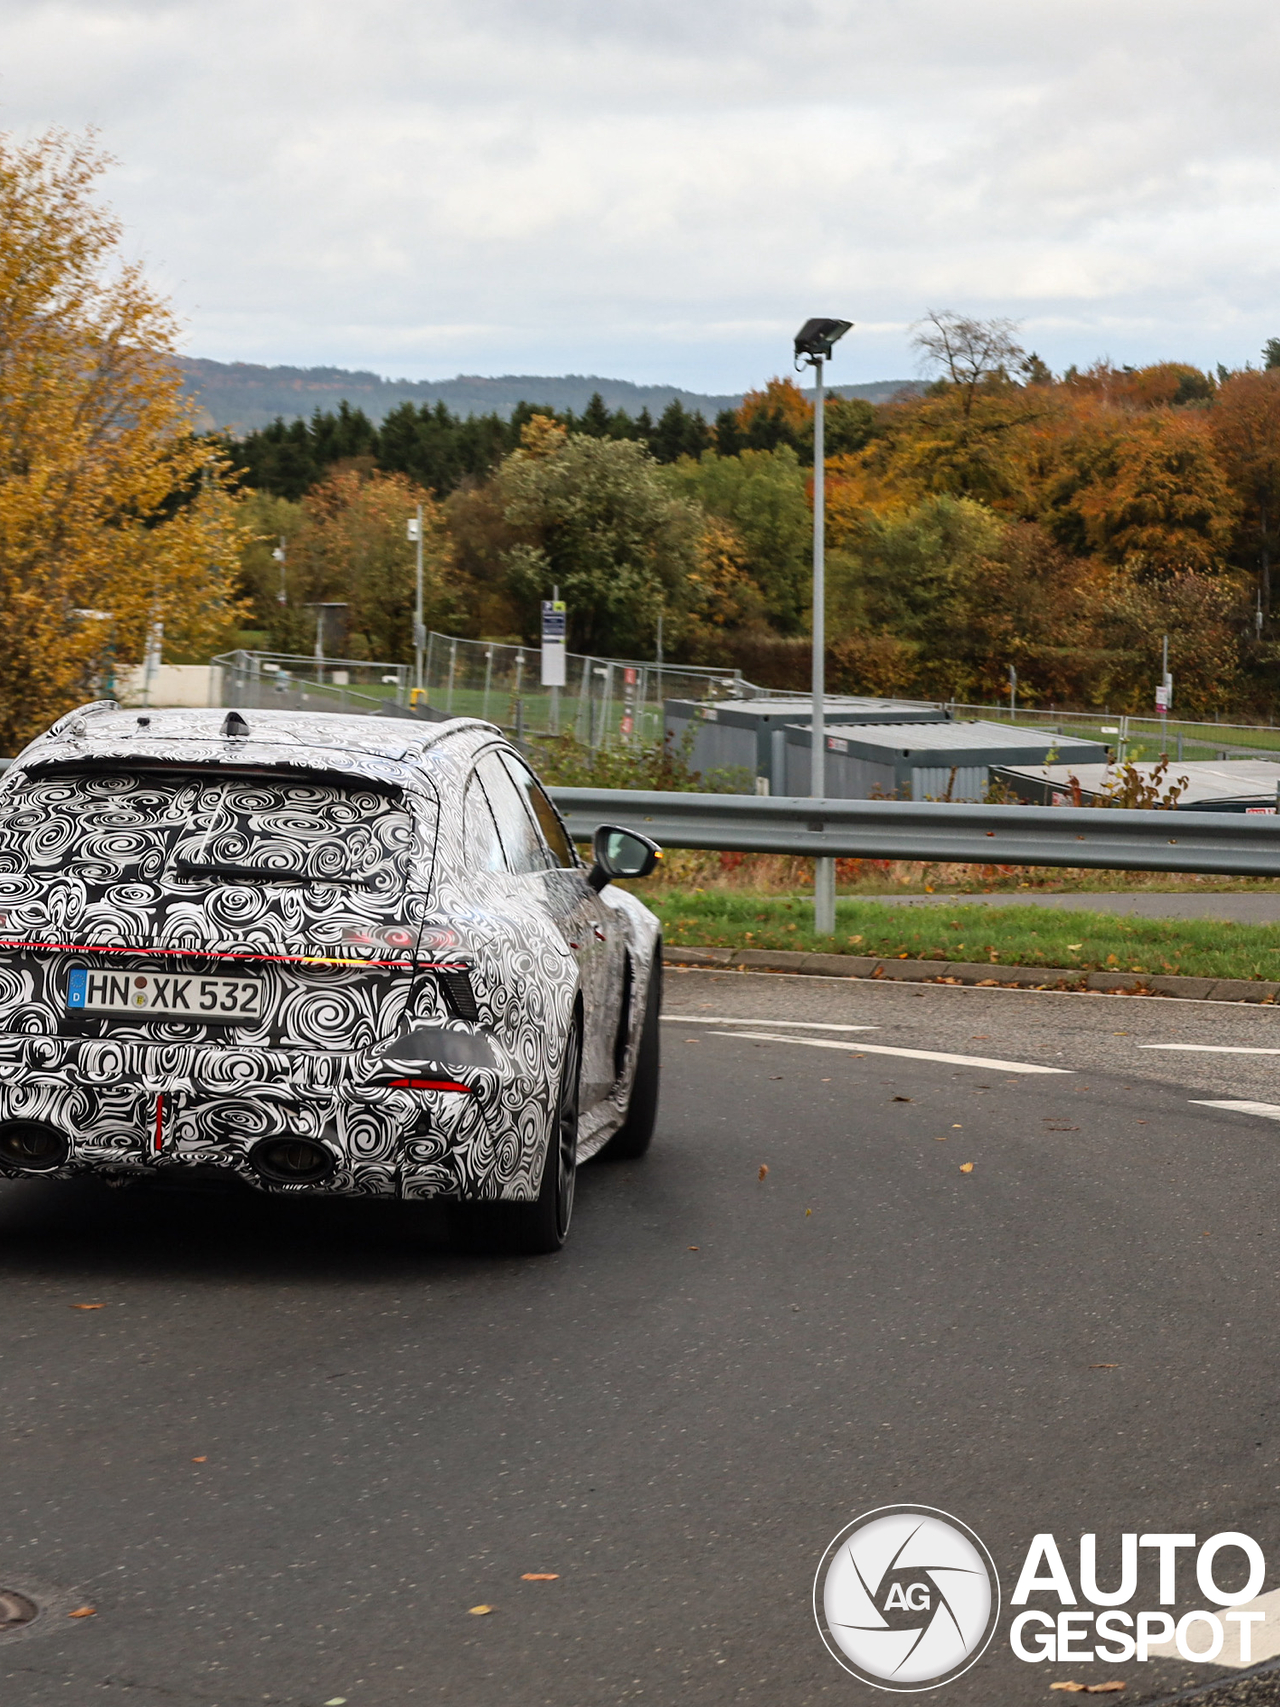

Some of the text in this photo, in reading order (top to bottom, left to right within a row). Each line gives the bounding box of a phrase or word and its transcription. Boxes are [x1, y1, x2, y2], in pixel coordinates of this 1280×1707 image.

[72, 992, 80, 1002] D
[87, 974, 259, 1013] HN XK 532
